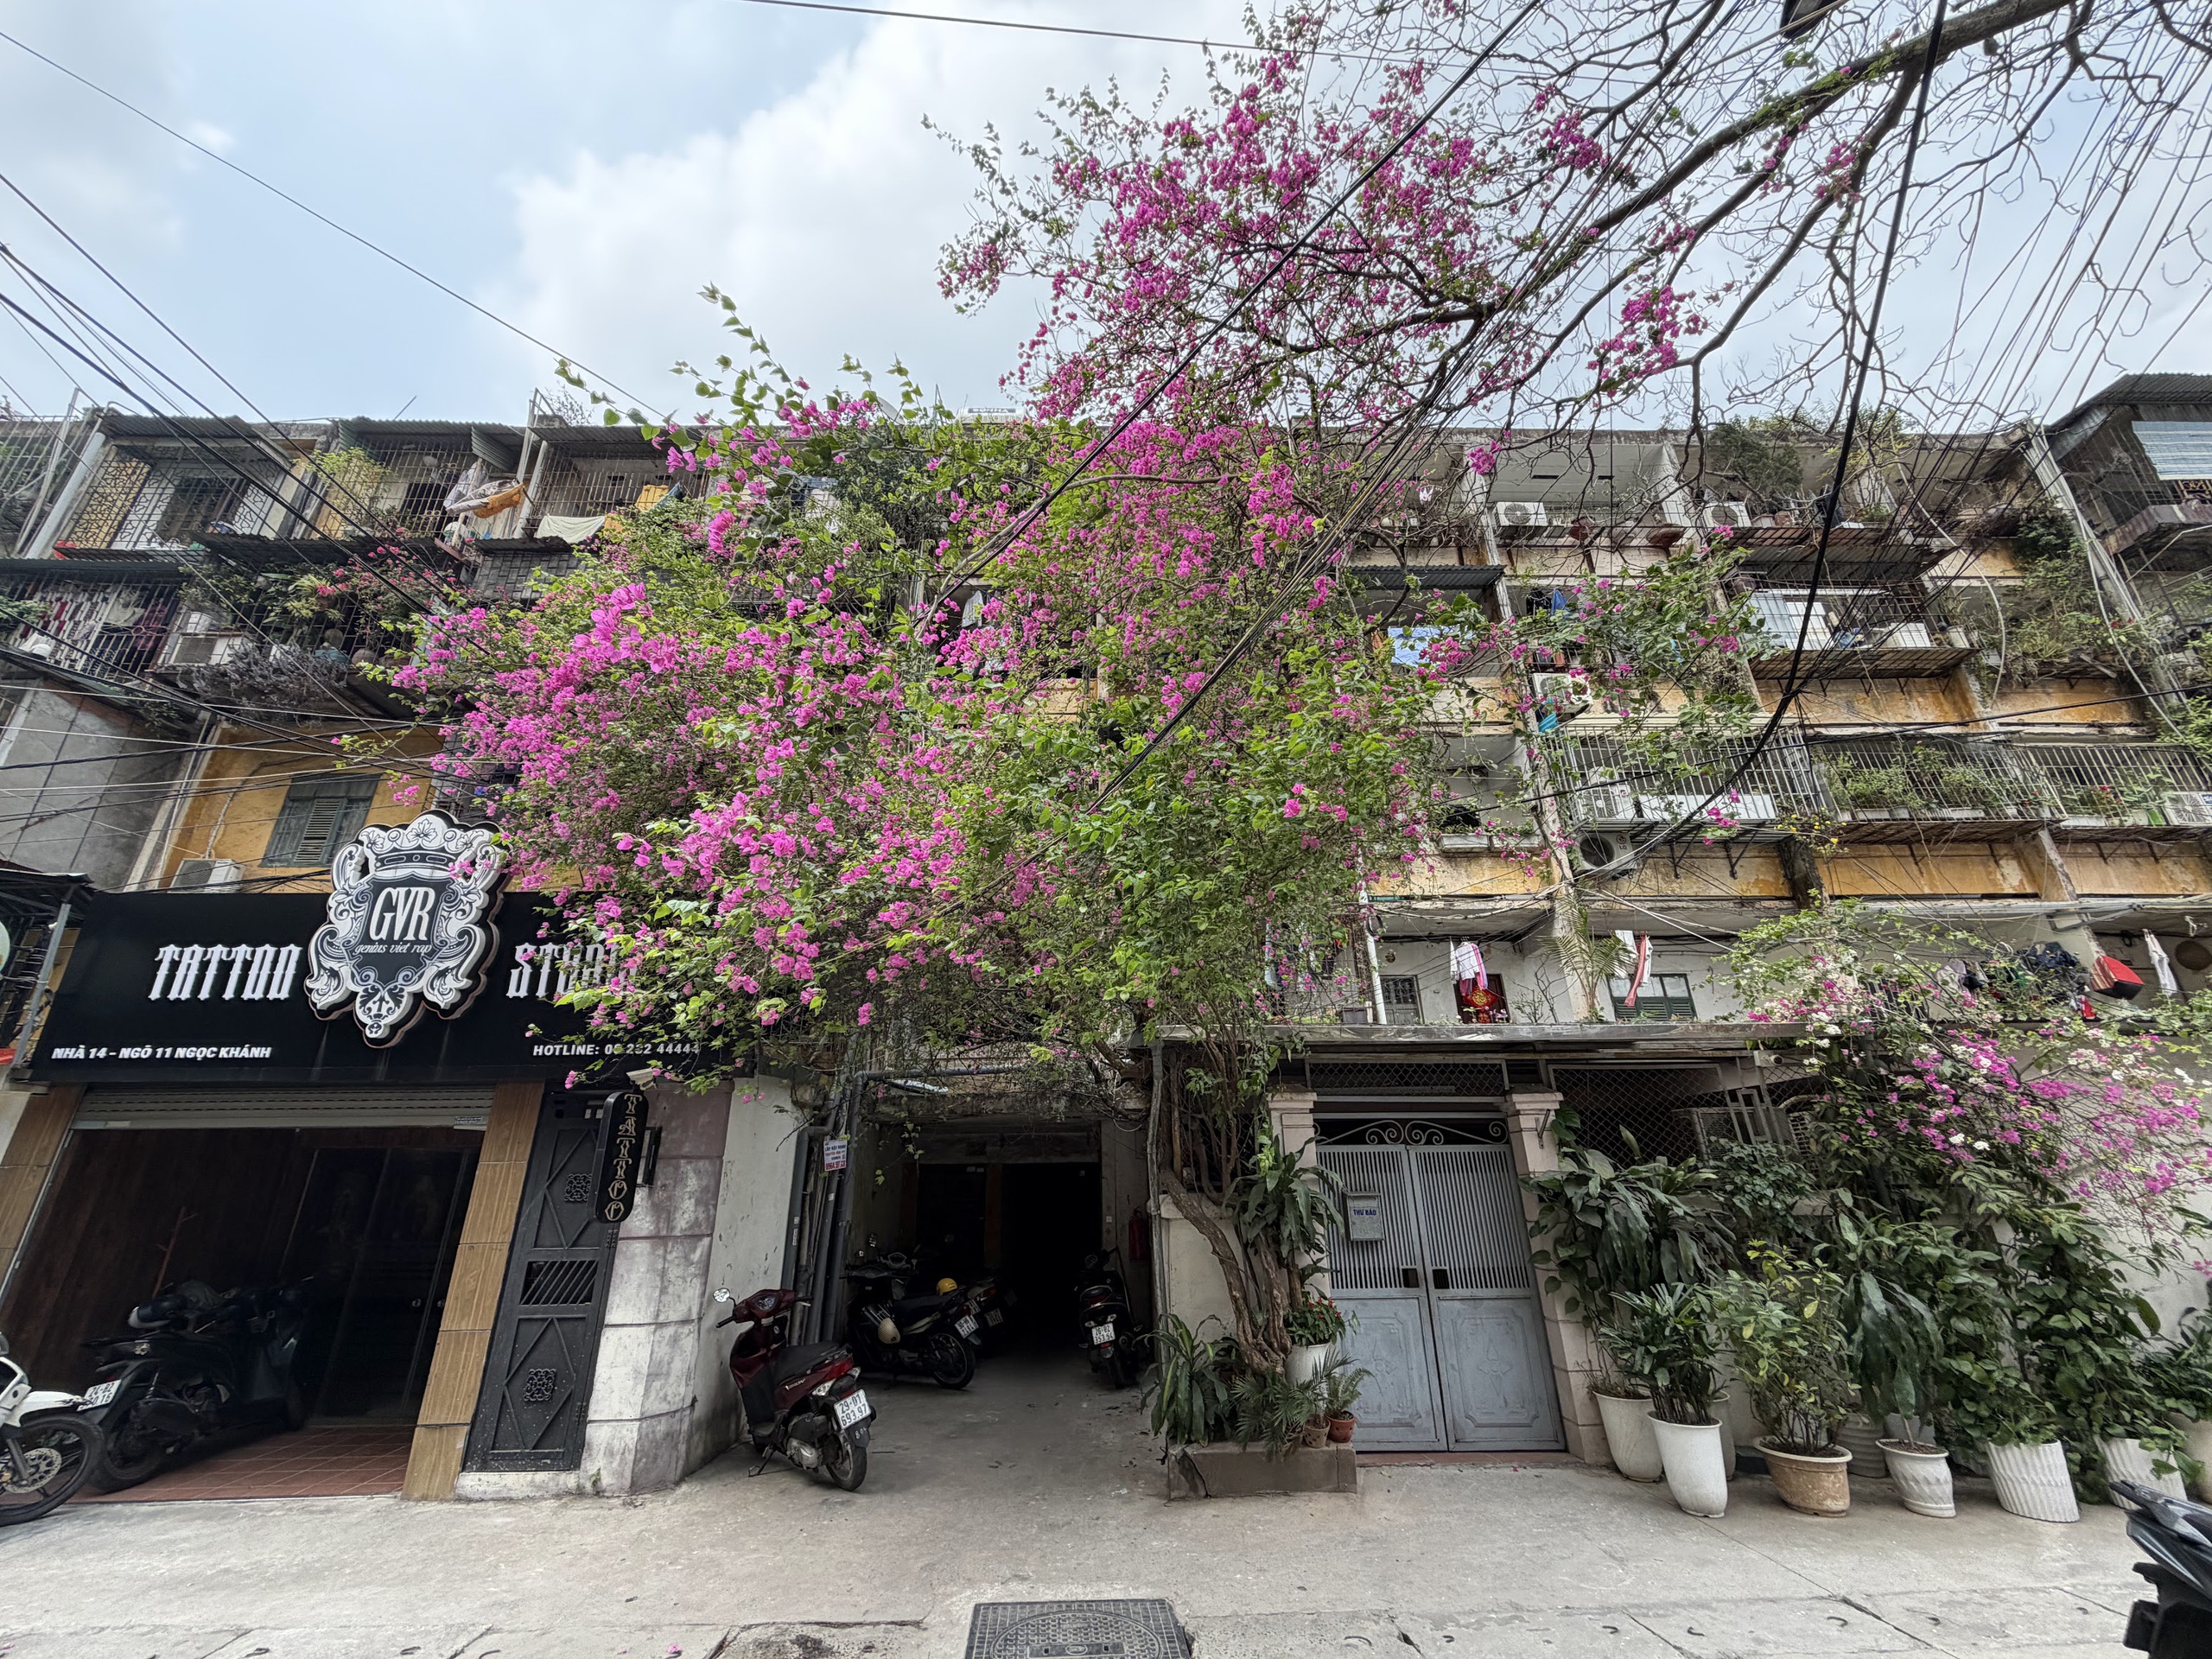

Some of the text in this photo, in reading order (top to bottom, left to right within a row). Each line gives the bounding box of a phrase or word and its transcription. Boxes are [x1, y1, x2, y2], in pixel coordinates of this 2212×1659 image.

[370, 887, 435, 940] GVR
[353, 942, 432, 957] genius viet rap
[148, 942, 639, 1001] TATTOO STUD
[51, 1045, 85, 1059] NHÀ
[89, 1047, 108, 1058] 14
[118, 1045, 153, 1058] NGÕ
[156, 1047, 173, 1058] 11
[174, 1047, 218, 1061] NGỌC
[219, 1044, 272, 1058] KHÁNH
[532, 1044, 600, 1056] HOTLINE:
[657, 1043, 699, 1054] 44444
[605, 1094, 643, 1221] TATTOO
[841, 1403, 868, 1427] 693.97
